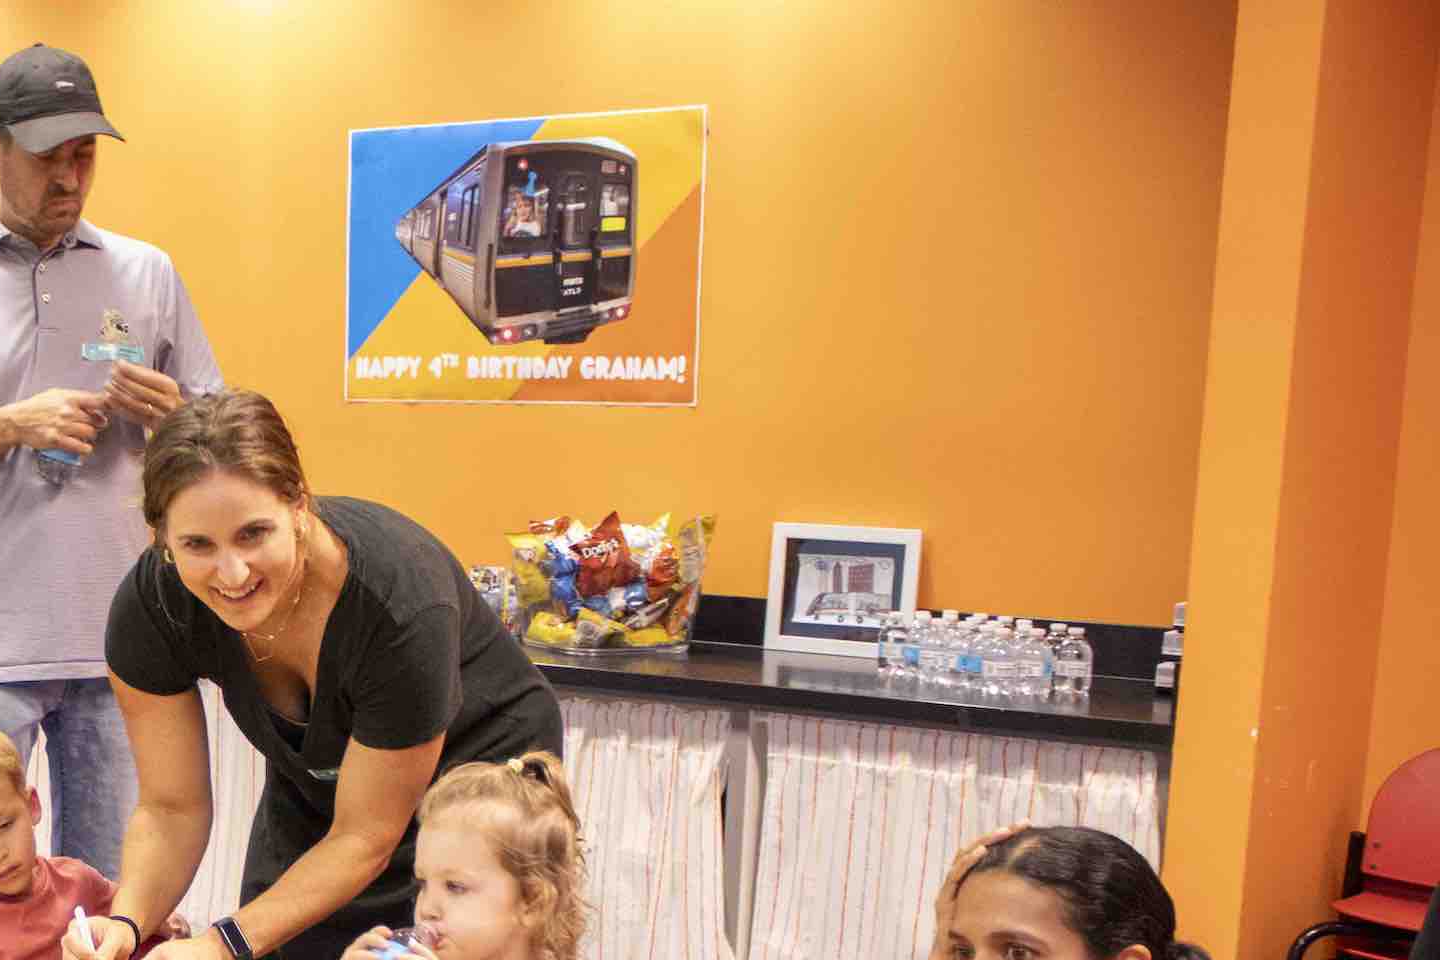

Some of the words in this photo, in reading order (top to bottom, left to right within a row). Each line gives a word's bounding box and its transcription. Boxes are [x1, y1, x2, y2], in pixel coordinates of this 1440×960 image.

[355, 356, 421, 380] HAPPY
[466, 356, 572, 379] BIRTHDAY
[580, 356, 687, 383] GRAHAM!
